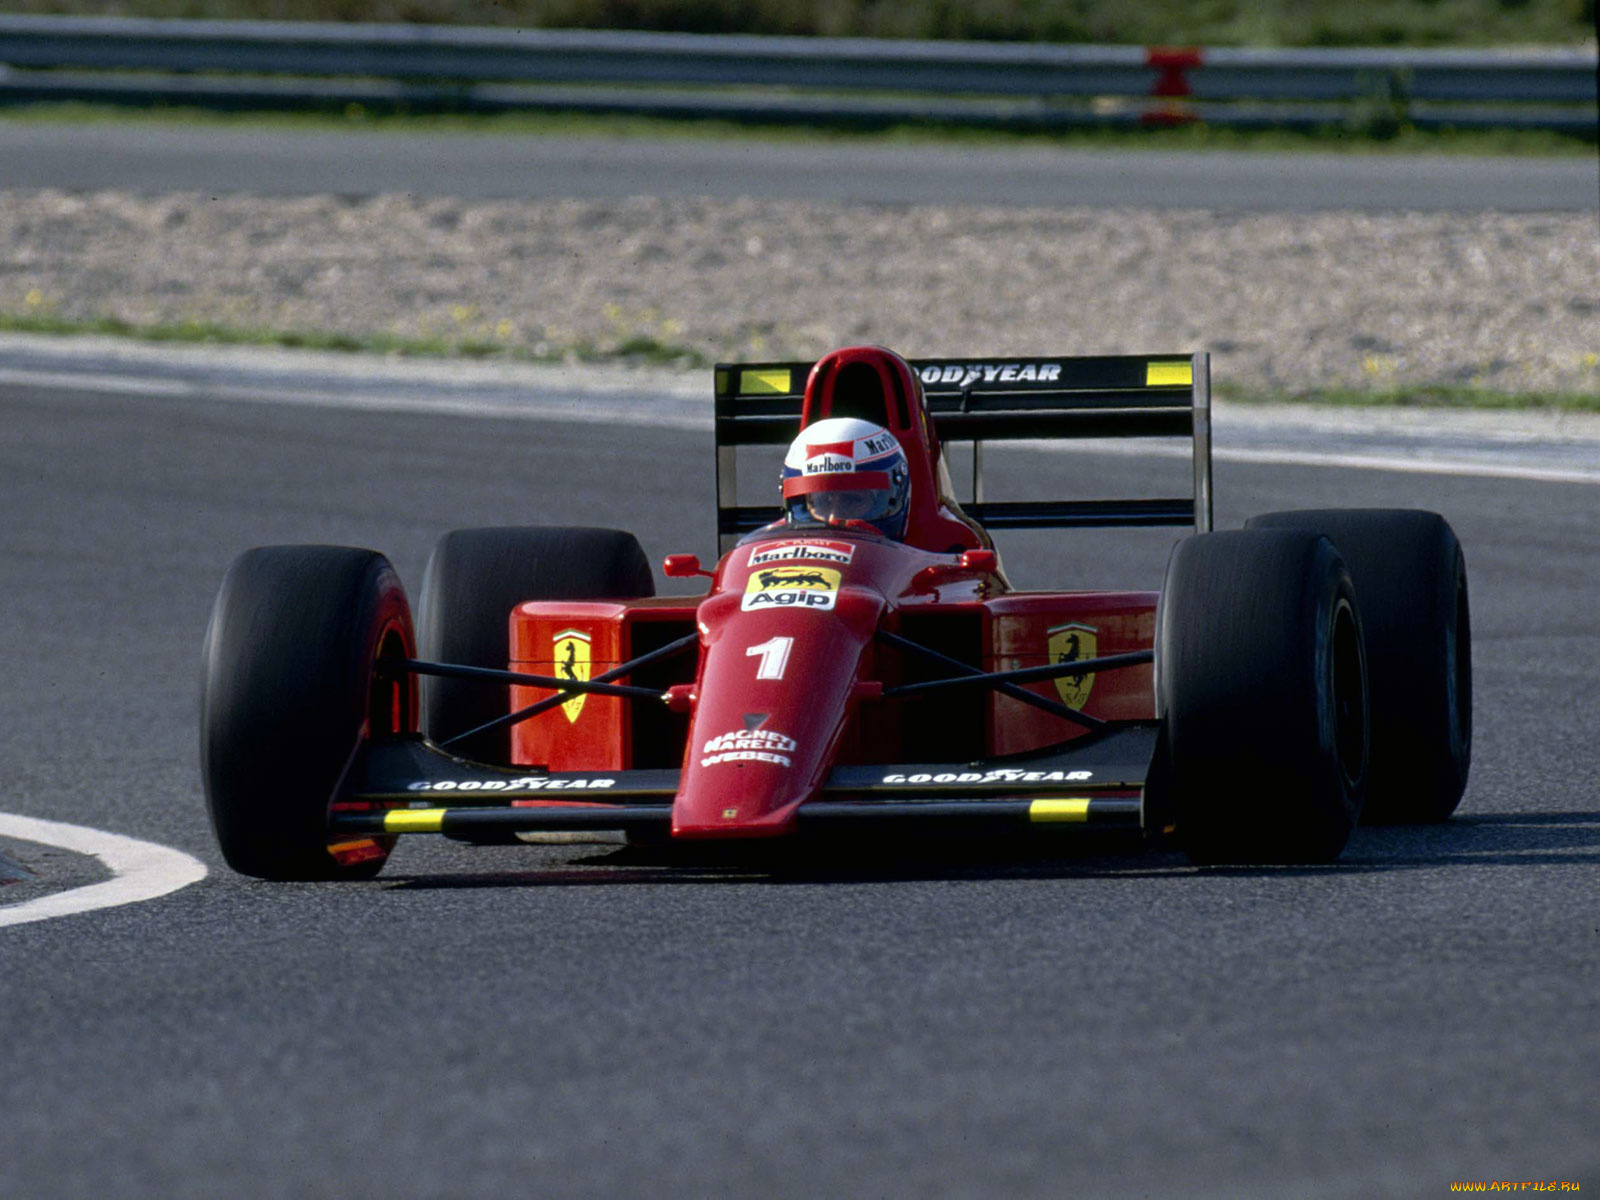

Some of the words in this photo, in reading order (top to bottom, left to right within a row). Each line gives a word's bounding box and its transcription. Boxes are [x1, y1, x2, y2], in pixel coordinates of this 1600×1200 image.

[913, 364, 1062, 387] ODYEAR
[806, 457, 853, 474] Marlboro
[753, 547, 850, 564] Marlboro
[748, 591, 831, 607] Agip
[746, 636, 794, 680] 1
[701, 751, 791, 767] WEBER
[407, 777, 616, 791] GOODYEAR
[882, 769, 1093, 783] GOODYEAR
